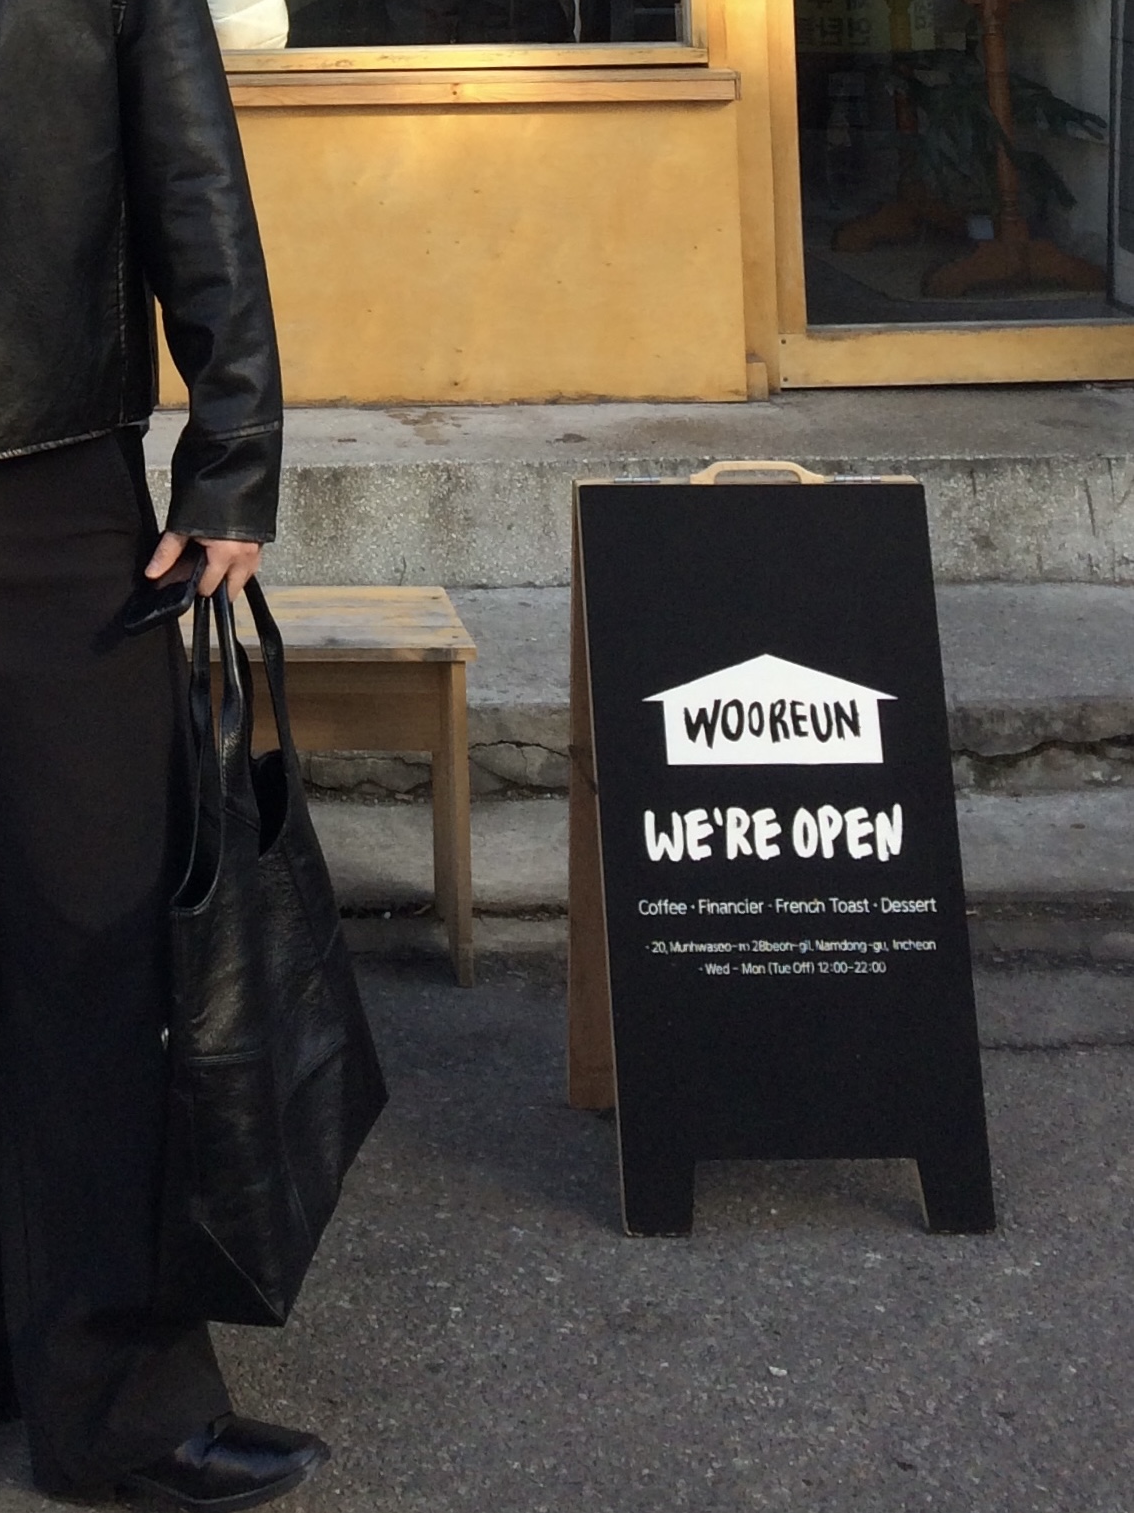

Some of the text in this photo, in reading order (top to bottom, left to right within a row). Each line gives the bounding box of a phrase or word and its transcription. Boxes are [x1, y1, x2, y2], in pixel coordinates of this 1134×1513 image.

[683, 698, 862, 750] WOOREUN
[644, 802, 904, 863] WE'RE OPEN
[638, 896, 938, 916] Coffee Financier French Toast Dessert
[892, 939, 937, 951] Incheon
[704, 962, 730, 975] Wed
[741, 962, 766, 975] Mon
[768, 961, 791, 976] (Tue
[792, 961, 815, 975] Off)
